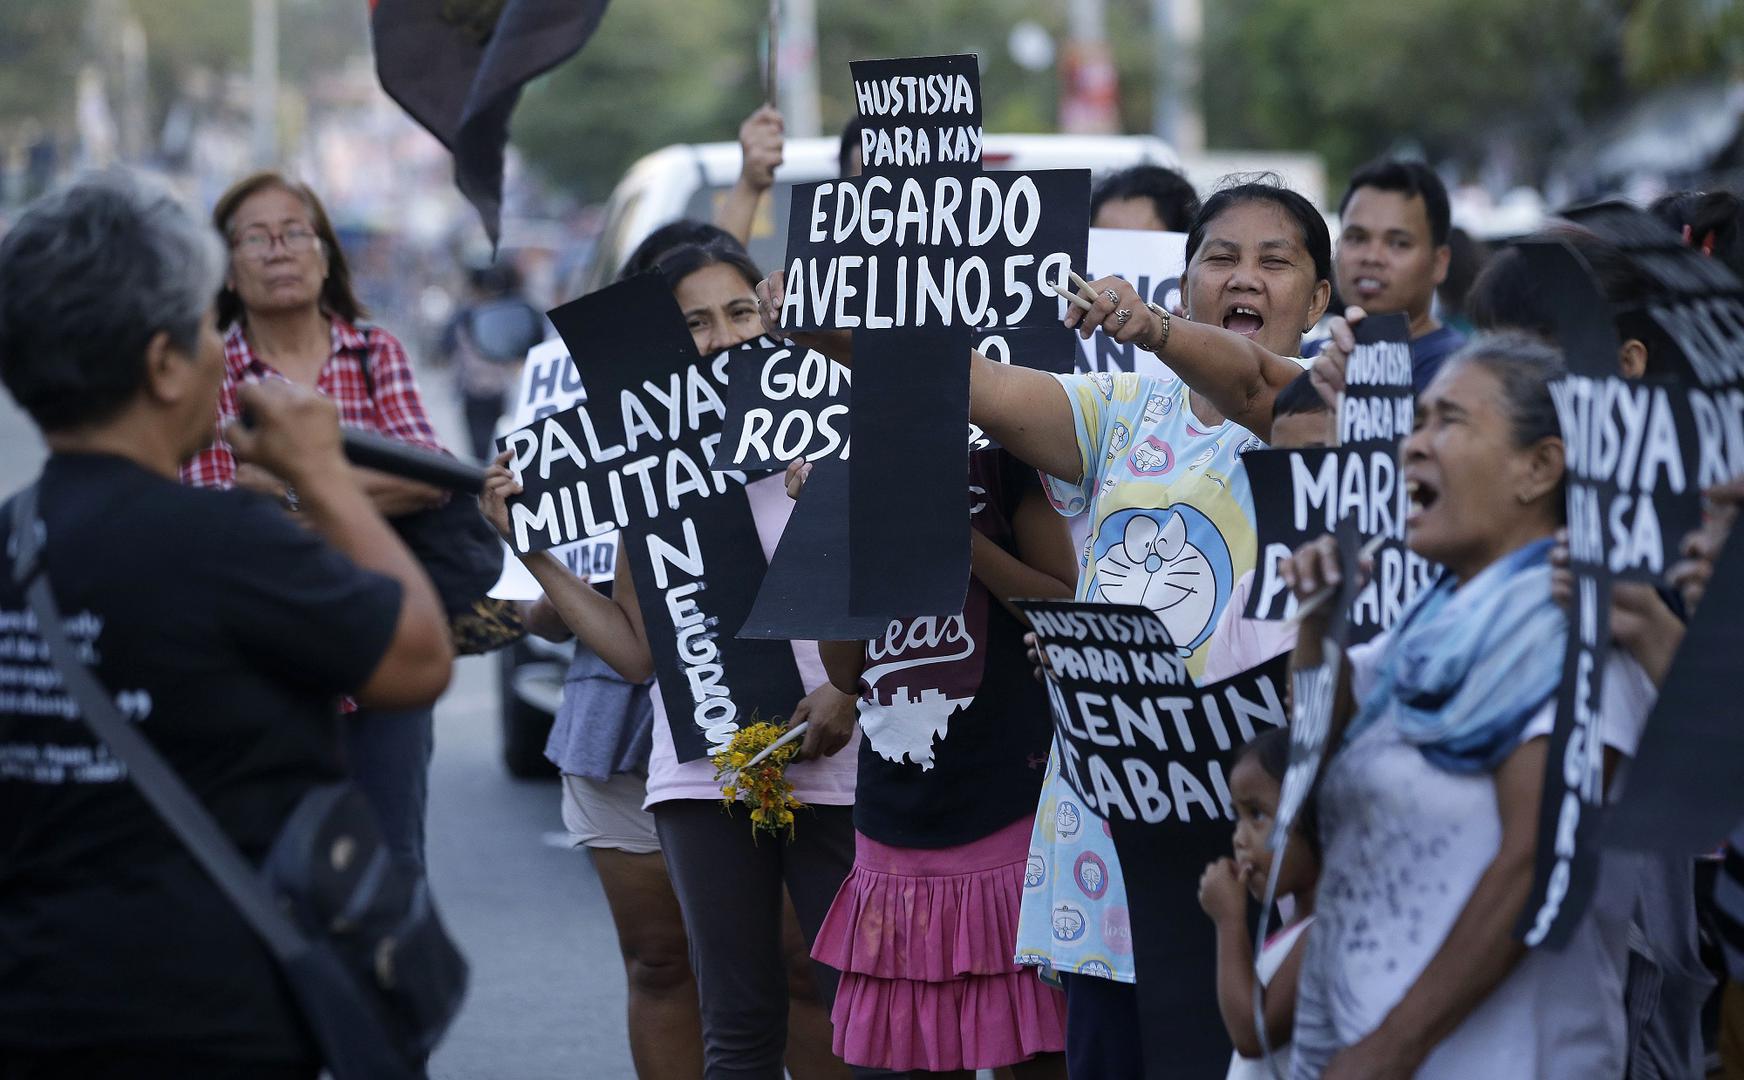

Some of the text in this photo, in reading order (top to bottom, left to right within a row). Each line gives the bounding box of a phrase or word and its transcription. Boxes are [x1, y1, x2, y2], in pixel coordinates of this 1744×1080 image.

[855, 74, 974, 116] HUSTISYA
[861, 125, 983, 166] PARA KAY
[809, 175, 1041, 247] EDGARDO
[1024, 609, 1172, 645] HUSTISYA
[1045, 645, 1187, 686] PARA KAY
